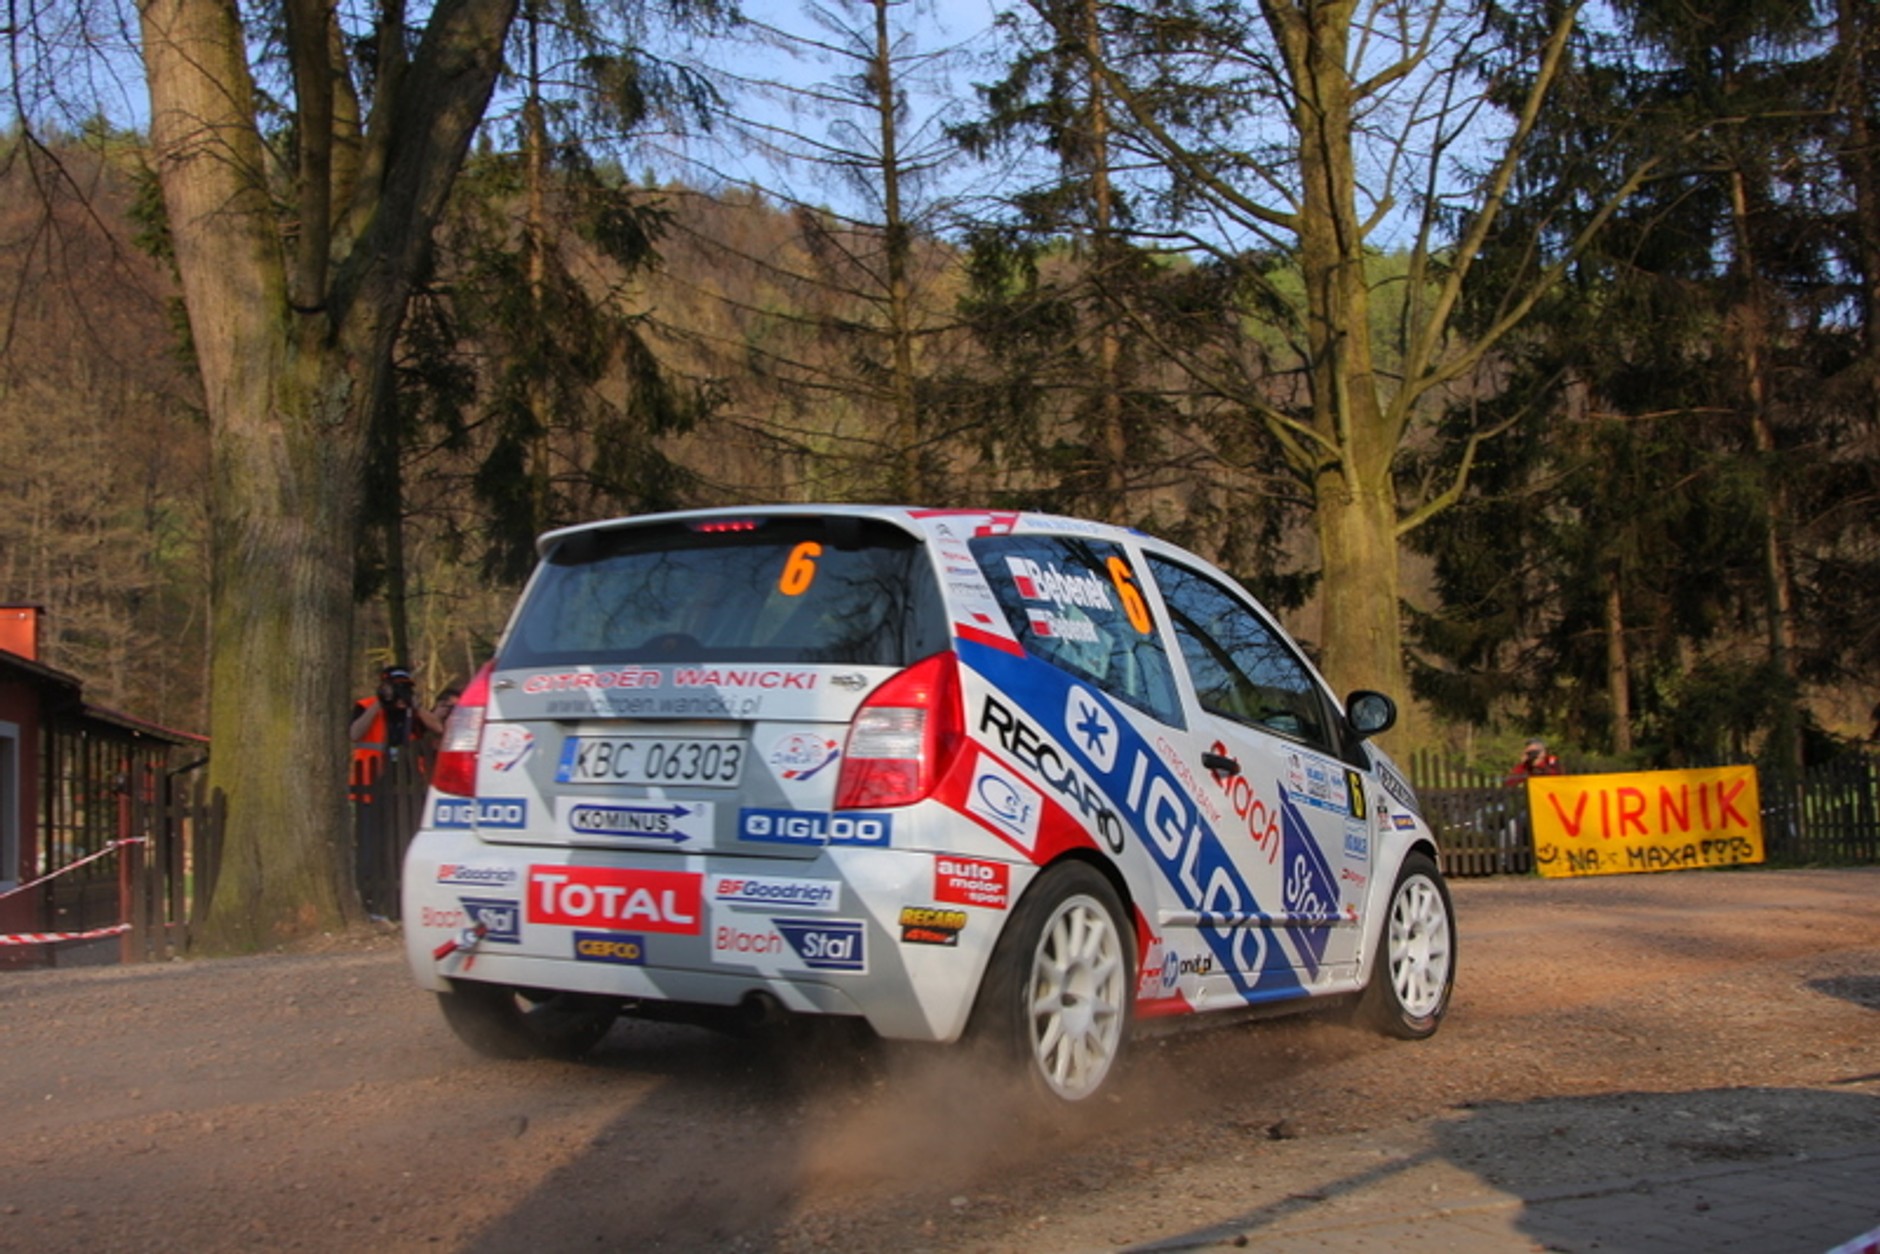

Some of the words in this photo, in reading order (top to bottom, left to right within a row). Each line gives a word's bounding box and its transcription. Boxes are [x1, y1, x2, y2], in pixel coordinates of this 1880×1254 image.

[779, 540, 822, 597] 6
[1106, 556, 1152, 634] 6
[673, 669, 817, 690] WANICKI
[576, 741, 635, 779] KBC
[644, 743, 741, 781] 06303
[980, 694, 1124, 855] RECARO
[453, 804, 523, 823] IGLOO
[577, 811, 670, 833] KOMINUS
[1548, 779, 1749, 839] VIRNIK
[776, 816, 882, 840] IGLOO
[938, 861, 994, 880] auto
[1127, 749, 1267, 988] IGLOO
[532, 873, 694, 924] TOTAL
[716, 879, 833, 901] BFGoodrich
[716, 926, 784, 954] Blach
[802, 932, 854, 960] Stal
